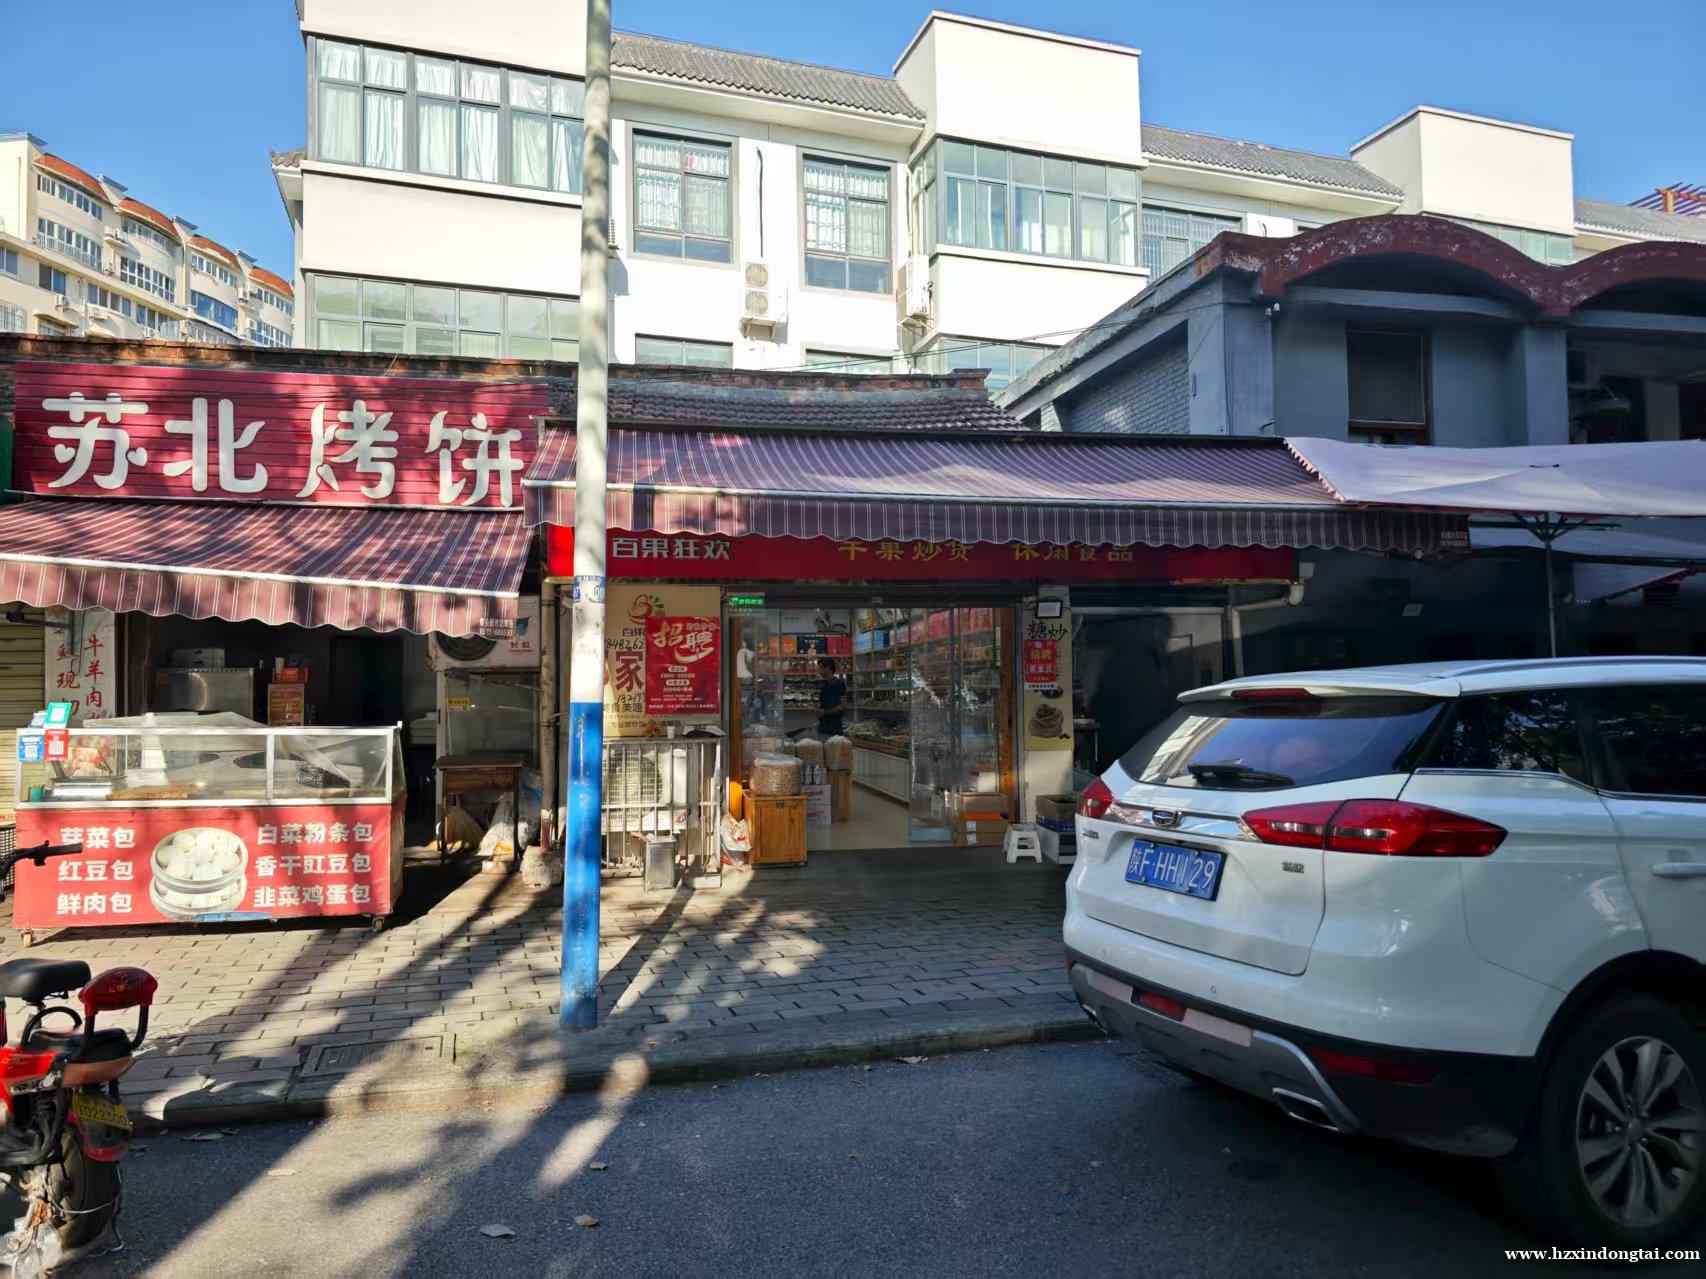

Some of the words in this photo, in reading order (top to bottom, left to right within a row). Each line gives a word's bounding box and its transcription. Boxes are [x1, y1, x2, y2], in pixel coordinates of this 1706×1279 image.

[42, 392, 524, 507] 苏北烤饼
[612, 537, 730, 560] 百果狂欢
[653, 621, 715, 663] 招聘
[616, 648, 644, 692] 家
[257, 821, 373, 845] 白菜粉条包
[57, 860, 134, 882] 红豆包
[255, 852, 371, 877] 香干豇豆包
[56, 891, 133, 915] 鲜肉包
[253, 883, 371, 908] 韭菜鸡蛋包
